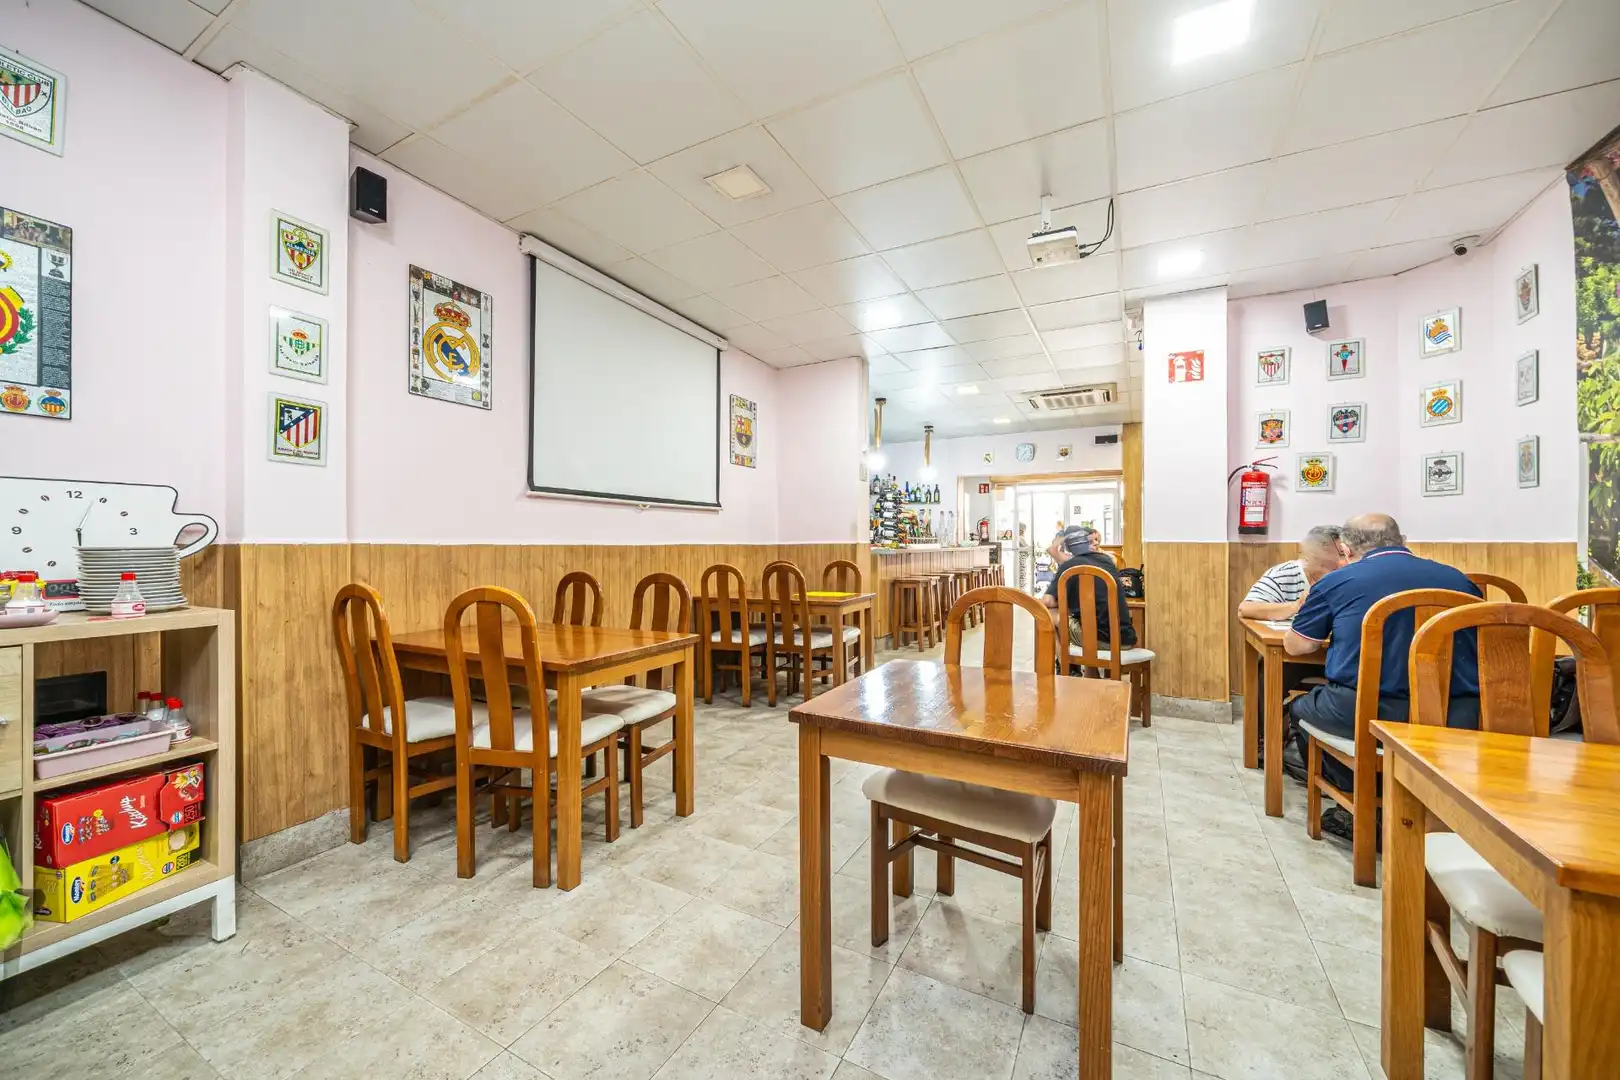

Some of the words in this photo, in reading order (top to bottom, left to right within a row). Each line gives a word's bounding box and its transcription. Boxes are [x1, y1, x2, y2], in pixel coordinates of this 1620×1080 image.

[65, 490, 83, 499] 12
[11, 526, 22, 535] 9
[129, 527, 138, 535] 3
